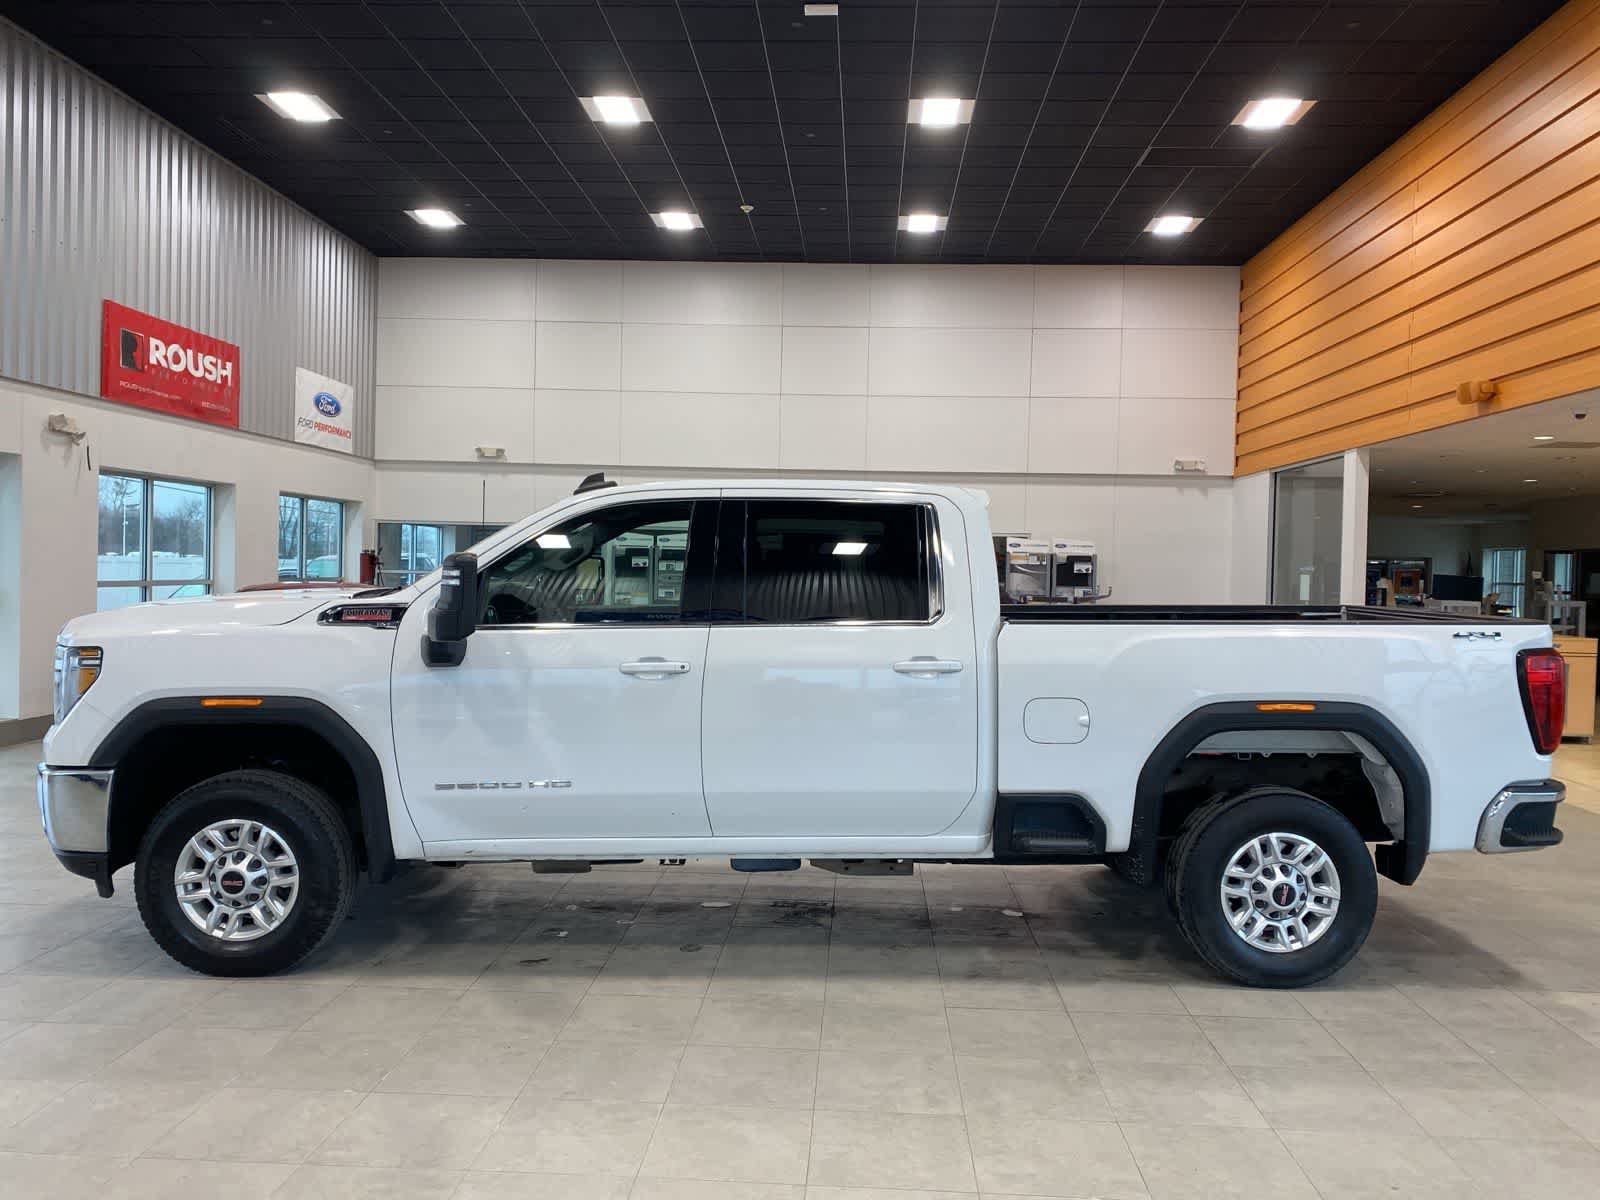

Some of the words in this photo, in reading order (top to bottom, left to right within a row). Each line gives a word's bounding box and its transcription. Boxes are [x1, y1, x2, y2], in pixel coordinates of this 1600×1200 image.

[149, 336, 232, 387] ROUSH
[318, 395, 338, 415] Ford
[297, 416, 314, 430] FORD
